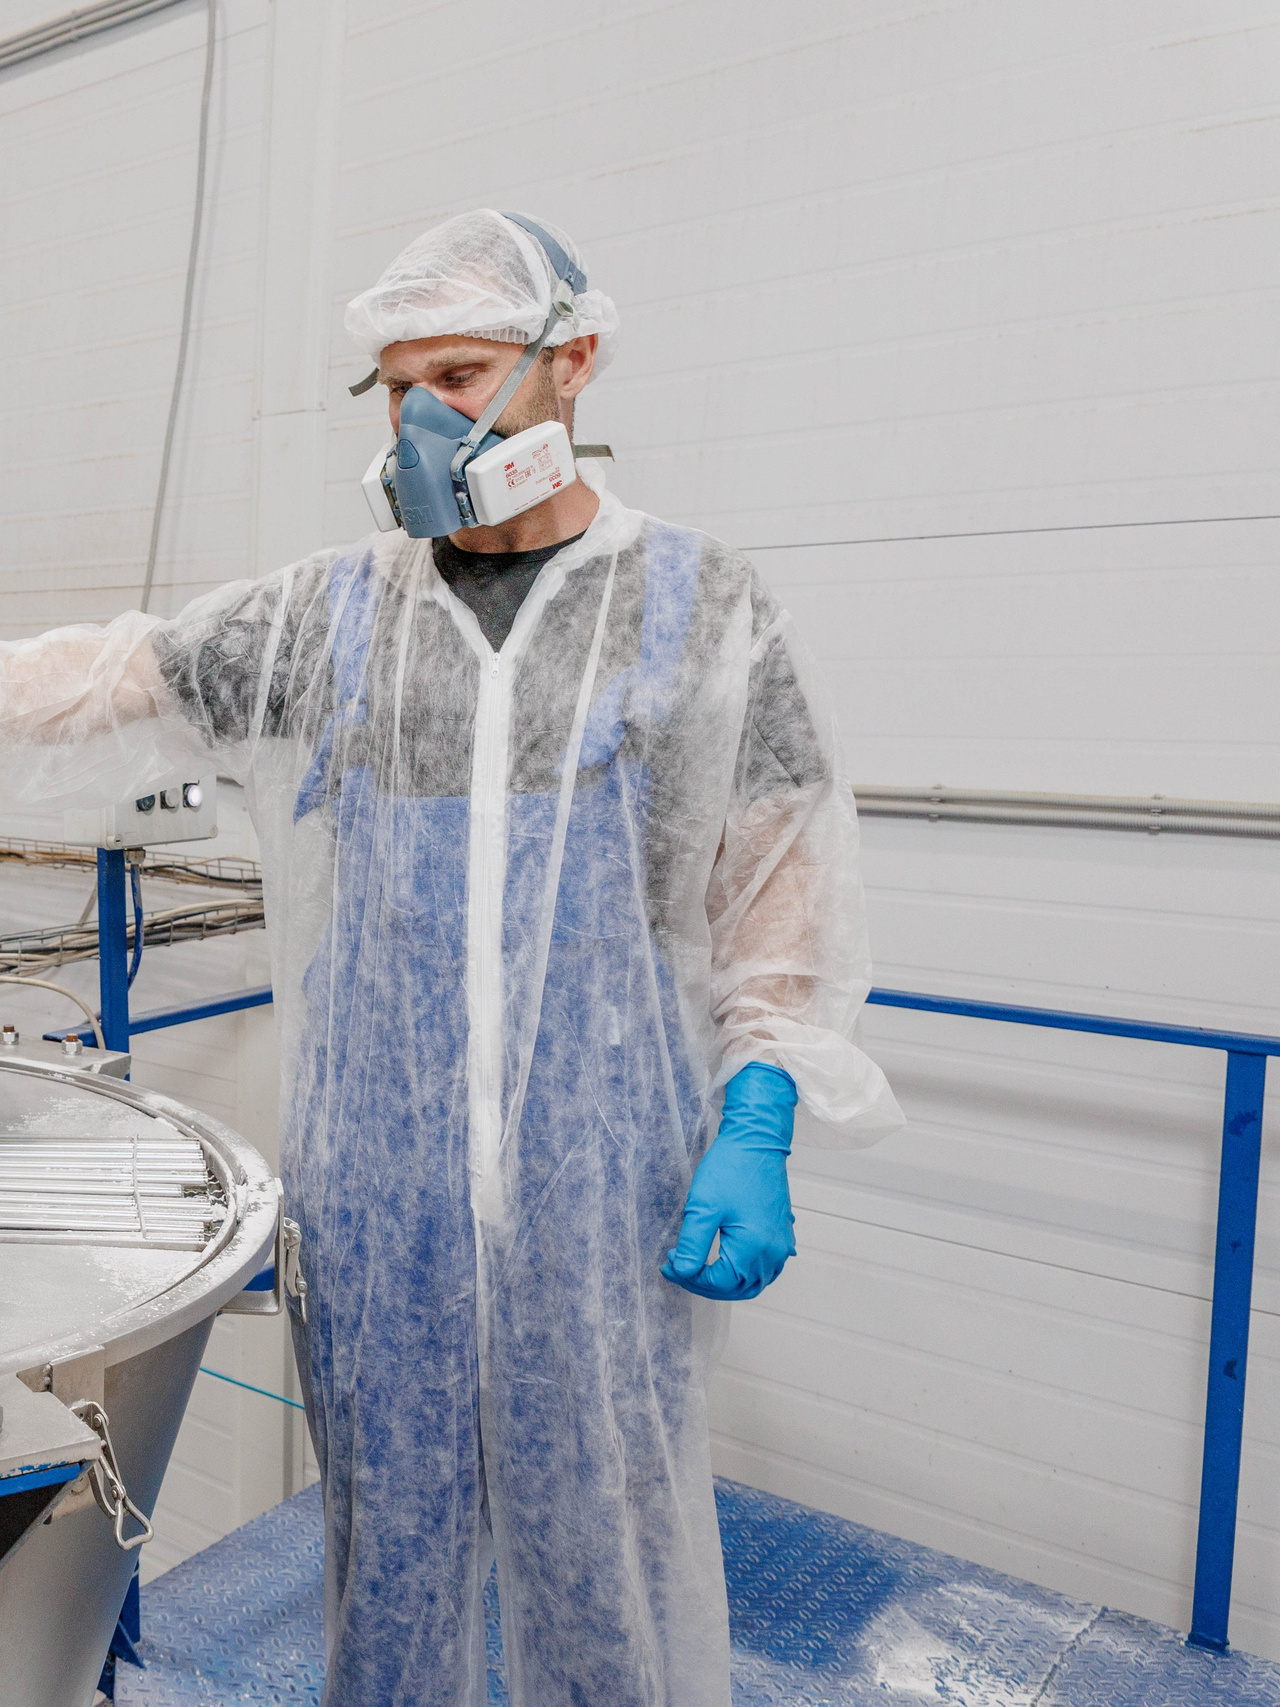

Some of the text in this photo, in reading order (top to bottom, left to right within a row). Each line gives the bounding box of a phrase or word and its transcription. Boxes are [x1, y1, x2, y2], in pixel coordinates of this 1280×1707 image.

[504, 462, 515, 471] 3M
[552, 480, 563, 489] 3M
[404, 505, 433, 524] 3M
